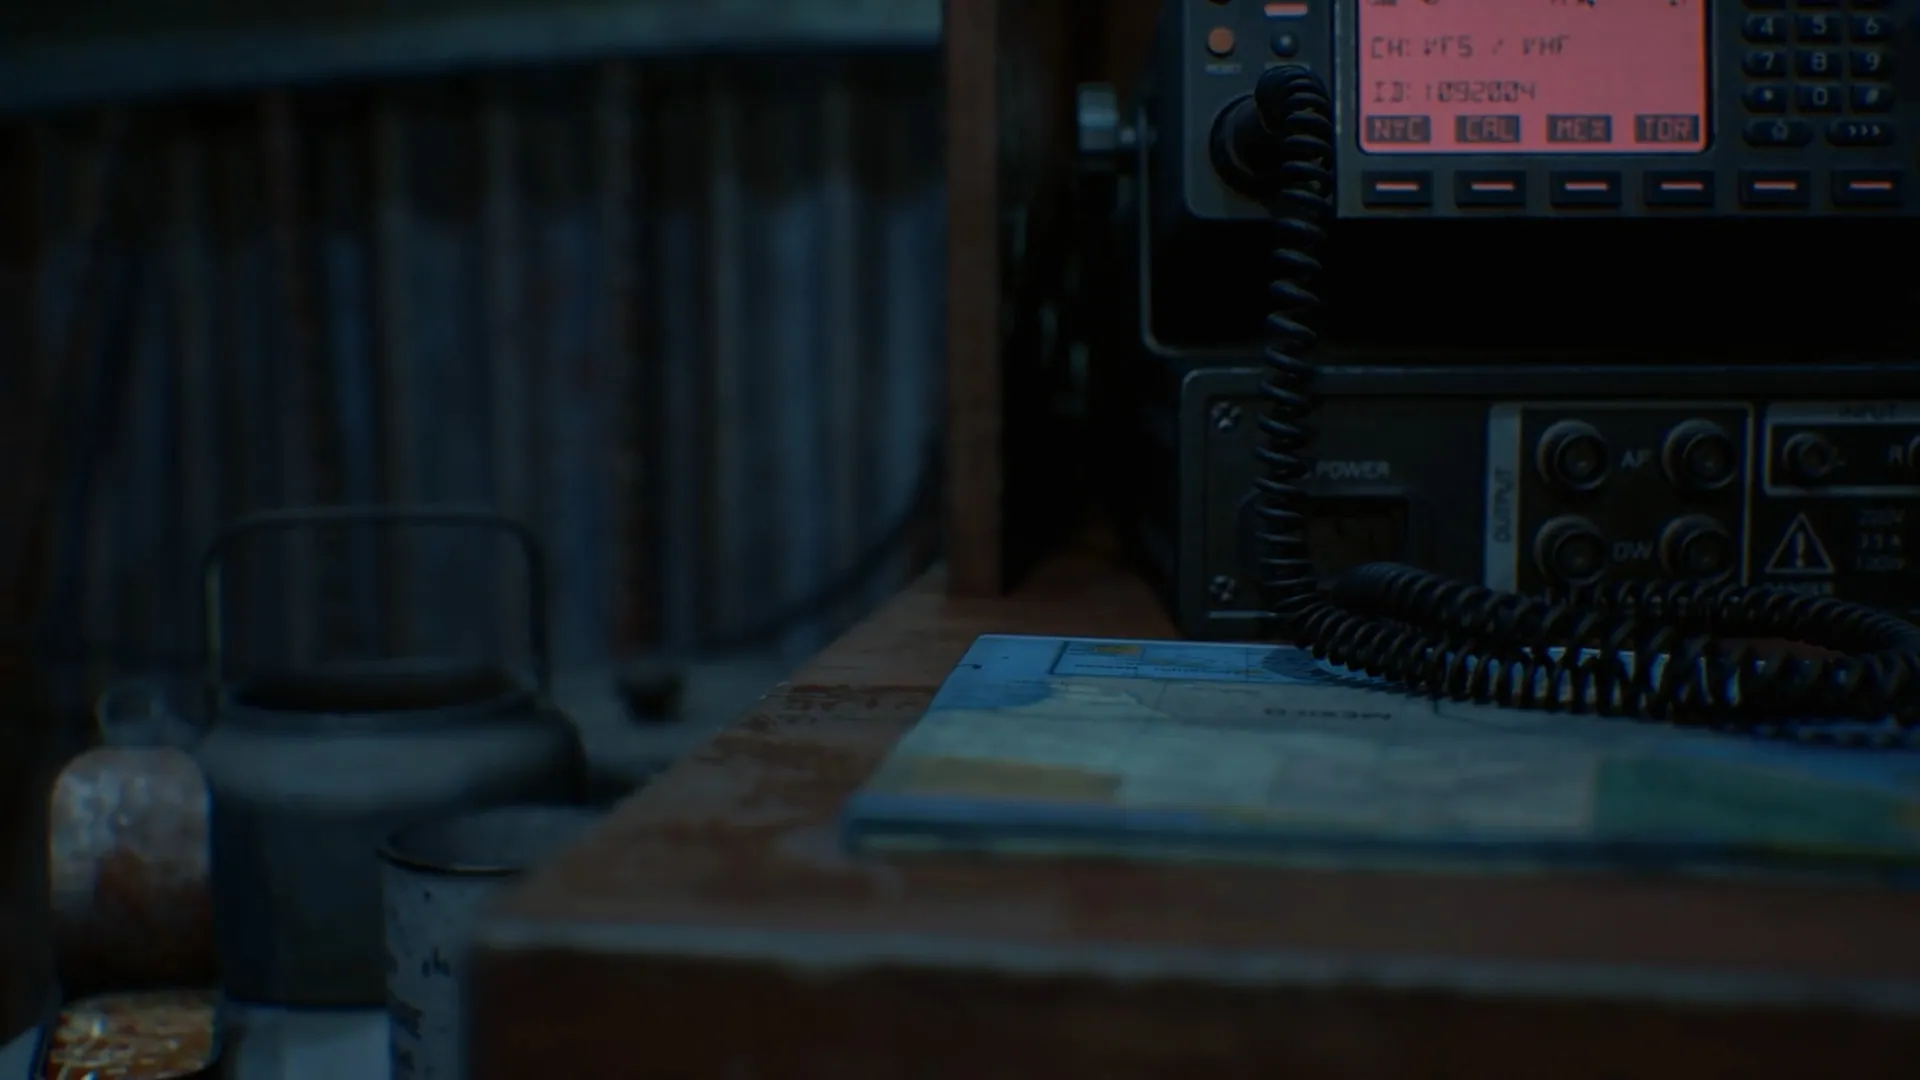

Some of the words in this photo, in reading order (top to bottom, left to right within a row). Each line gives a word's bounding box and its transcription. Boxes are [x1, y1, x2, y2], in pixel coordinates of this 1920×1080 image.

[1760, 16, 1774, 36] 4
[1811, 15, 1827, 35] 5
[1864, 16, 1880, 36] 6
[1763, 51, 1775, 70] 7
[1811, 52, 1827, 72] 8
[1865, 52, 1881, 72] 9
[1812, 87, 1828, 105] 0
[1374, 117, 1424, 141] NYC
[1466, 117, 1515, 141] CAL
[1556, 117, 1606, 141] MEX
[1645, 117, 1694, 141] TOR
[1316, 460, 1390, 480] POWER
[1493, 468, 1512, 543] OUTPUT
